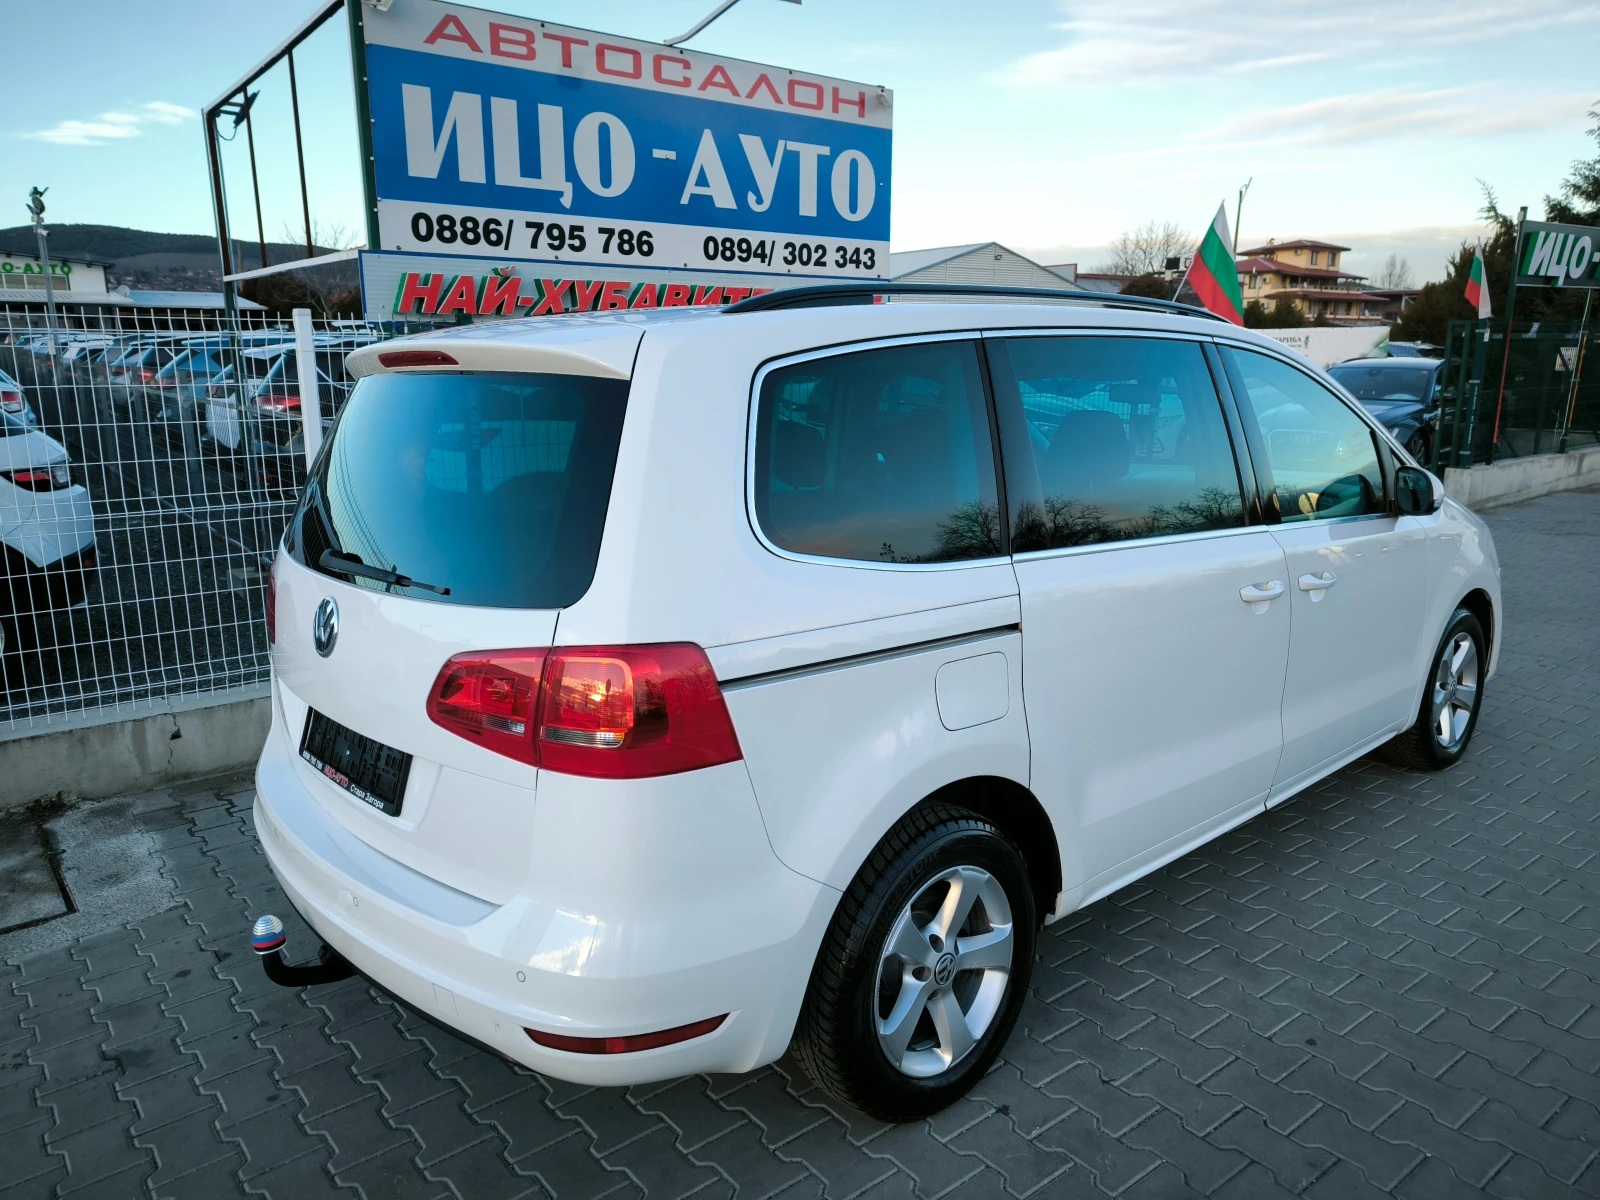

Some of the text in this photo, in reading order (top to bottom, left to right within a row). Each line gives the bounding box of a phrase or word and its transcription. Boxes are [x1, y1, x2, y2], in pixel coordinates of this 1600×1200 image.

[423, 13, 866, 119] АВТОСАЛОН
[411, 212, 654, 258] 0886/ 795 786
[703, 235, 876, 271] 0894/ 302 343
[350, 784, 366, 799] Стара
[364, 792, 384, 810] Загора
